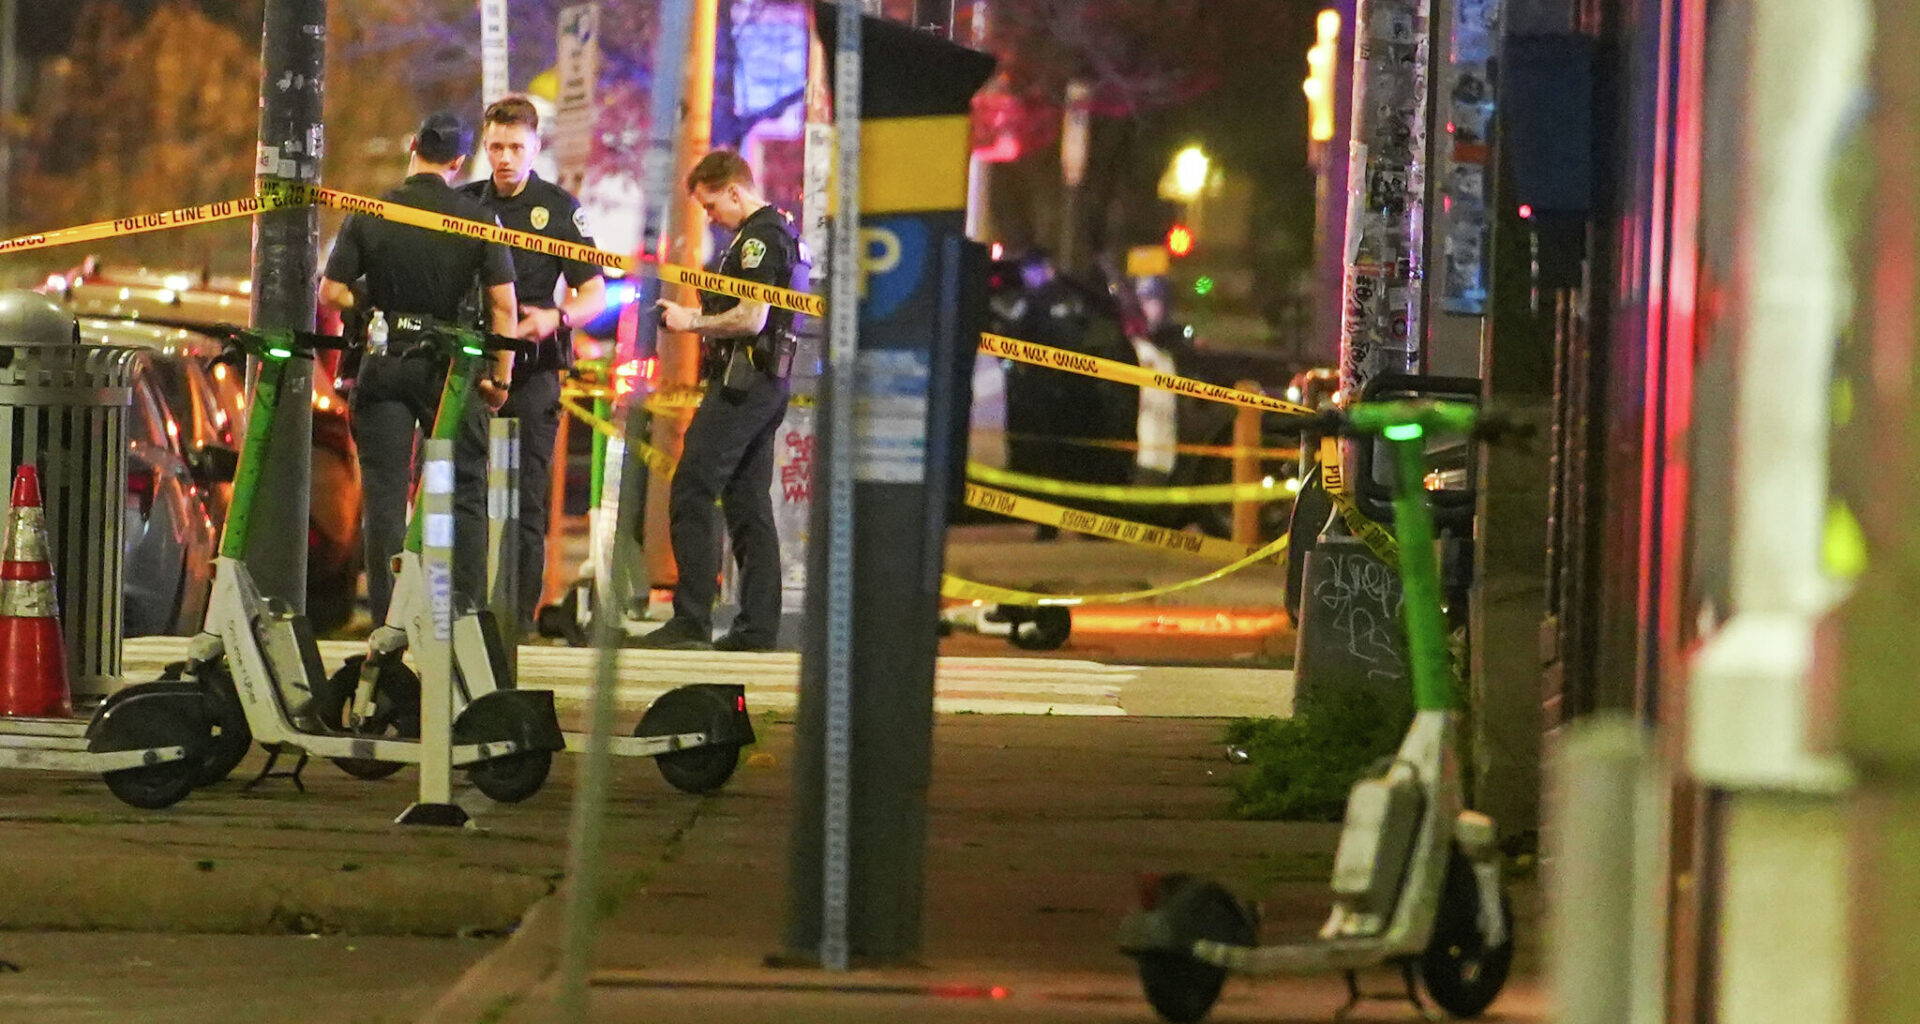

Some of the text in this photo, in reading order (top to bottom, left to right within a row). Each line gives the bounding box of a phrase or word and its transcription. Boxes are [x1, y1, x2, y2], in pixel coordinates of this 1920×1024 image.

[114, 212, 168, 232] POLICE
[172, 207, 205, 223] LINE
[211, 201, 231, 217] DO
[238, 198, 265, 212] NOT
[442, 217, 623, 268] POLICE LINE DO NOT CROSS
[680, 271, 725, 292] POLICE
[730, 281, 759, 300] LINE
[763, 290, 781, 306] DO
[786, 293, 811, 313] NOT
[1023, 345, 1049, 364] NOT
[1053, 351, 1098, 374] CROSS
